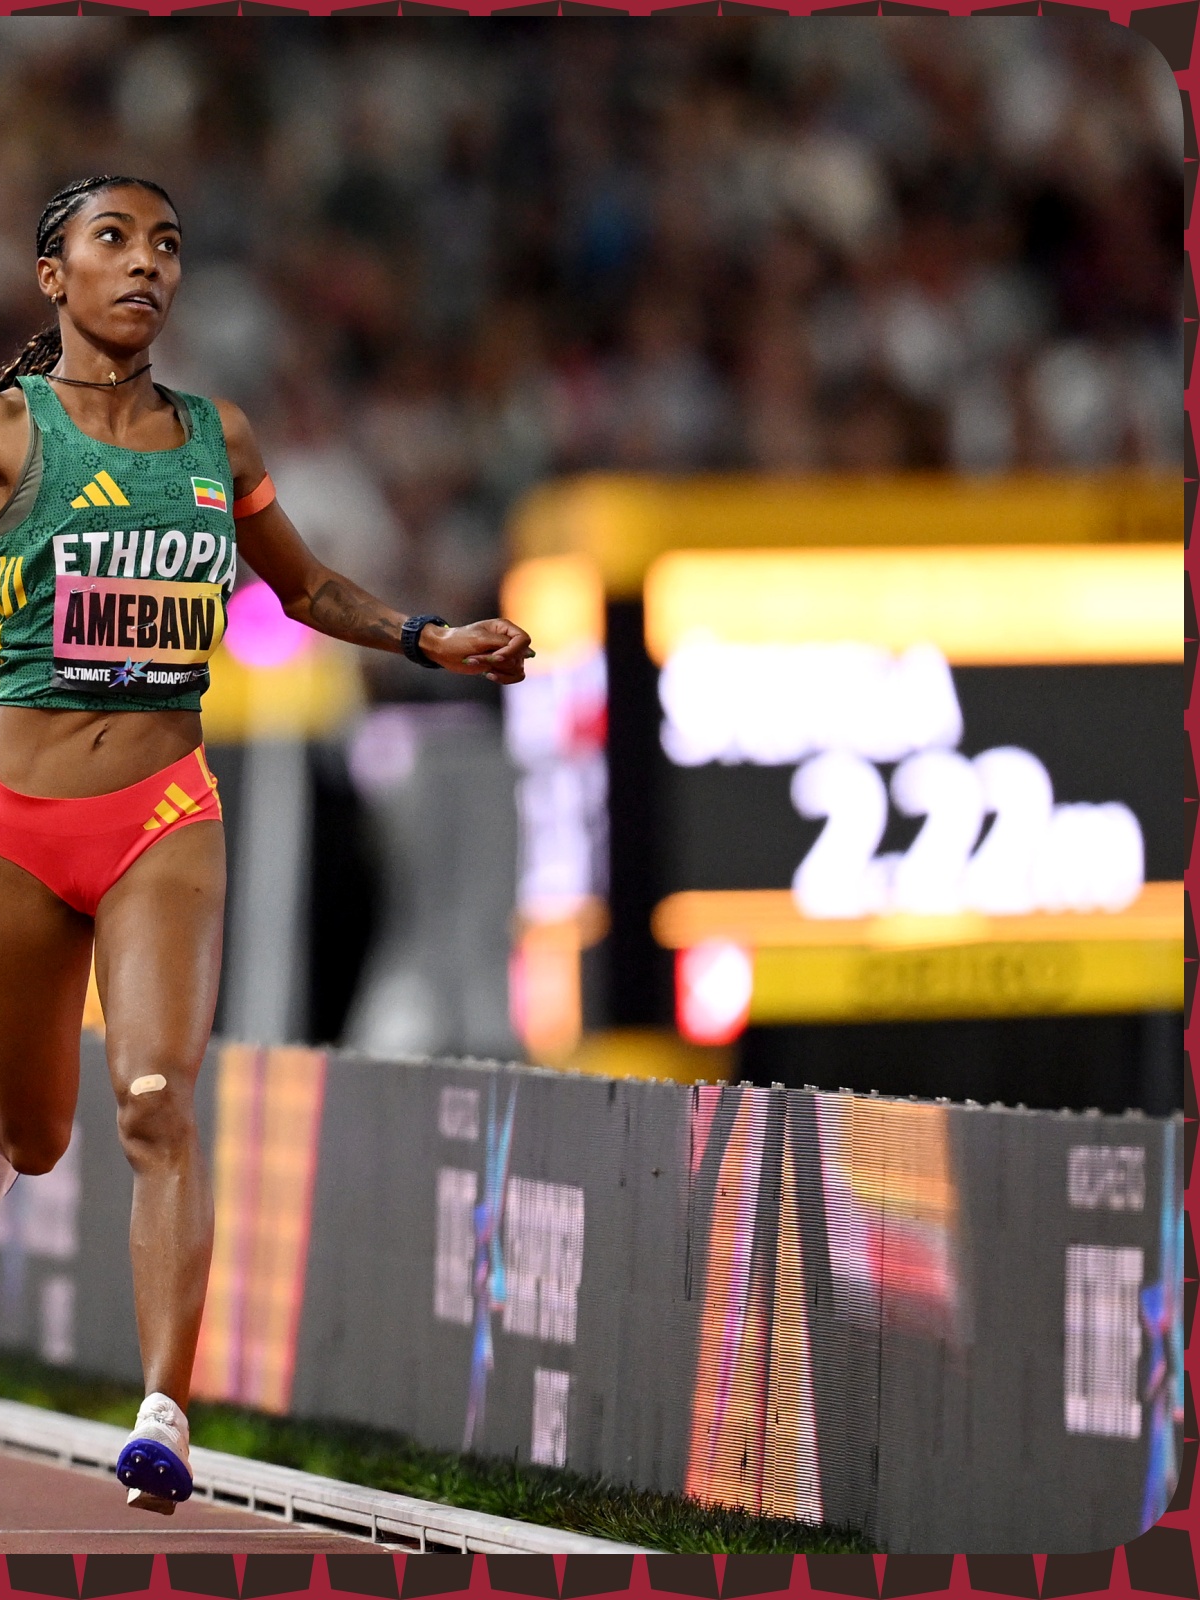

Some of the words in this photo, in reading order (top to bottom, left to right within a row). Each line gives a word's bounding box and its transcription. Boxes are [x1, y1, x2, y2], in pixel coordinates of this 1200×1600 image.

[53, 530, 237, 593] ETHIOPIA
[63, 591, 215, 651] AMEBAW
[64, 666, 111, 682] ULTIMATE
[146, 670, 192, 685] BUDAPEST
